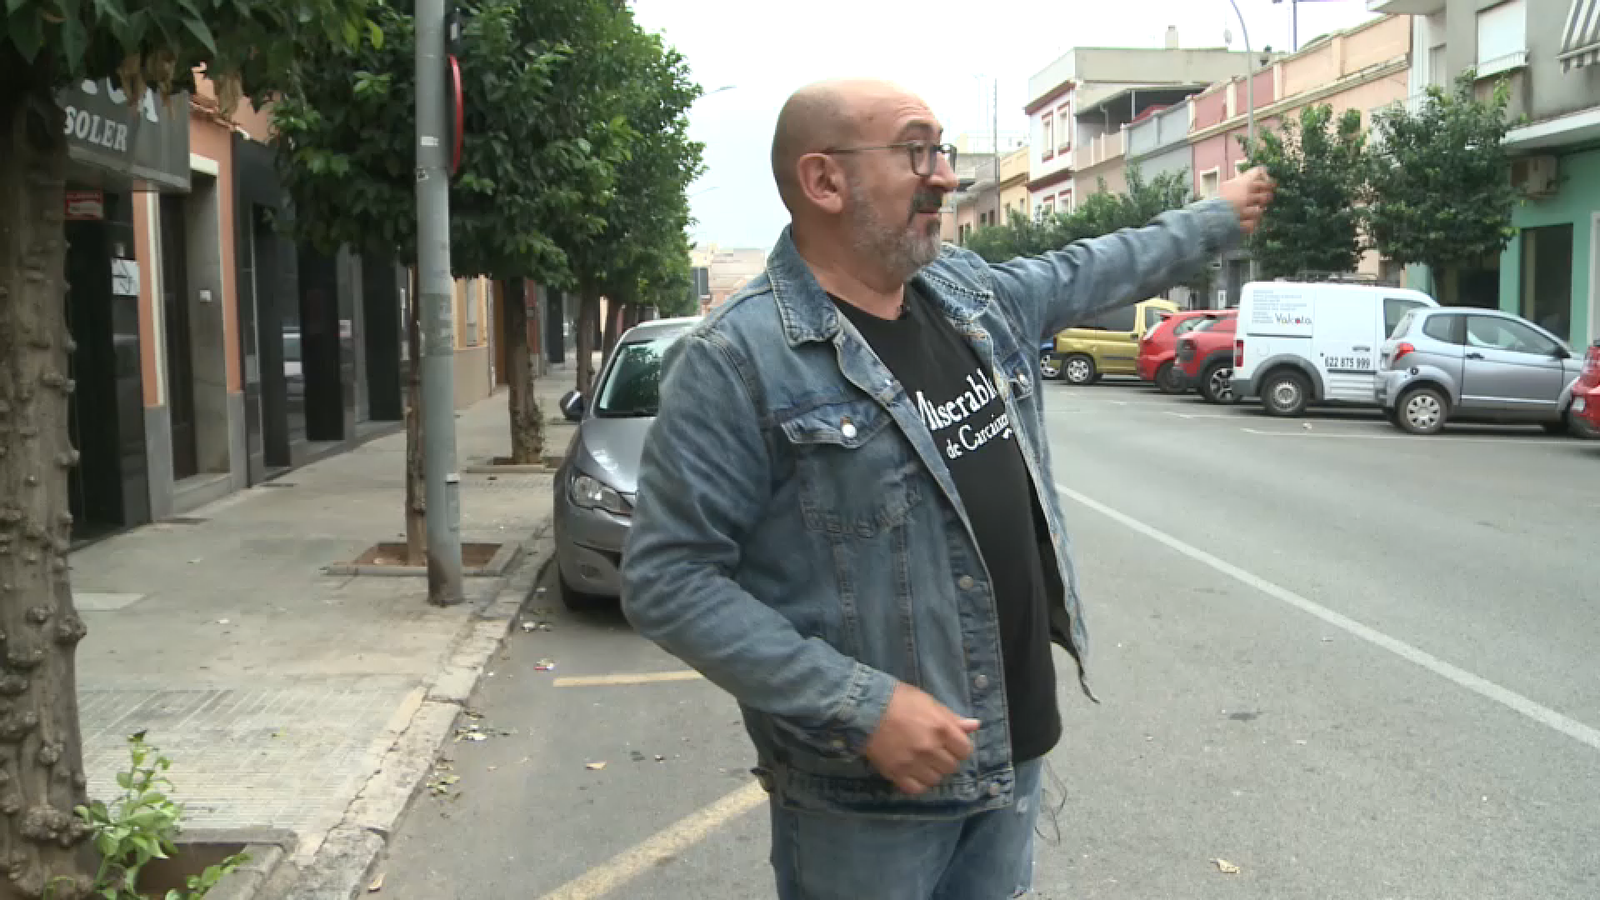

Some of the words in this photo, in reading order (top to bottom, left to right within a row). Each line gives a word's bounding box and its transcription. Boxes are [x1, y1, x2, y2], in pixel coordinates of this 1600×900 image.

[64, 105, 128, 153] SOLER
[1325, 356, 1339, 369] 622
[1340, 356, 1354, 369] 875
[1356, 357, 1371, 370] 999
[946, 438, 963, 460] de
